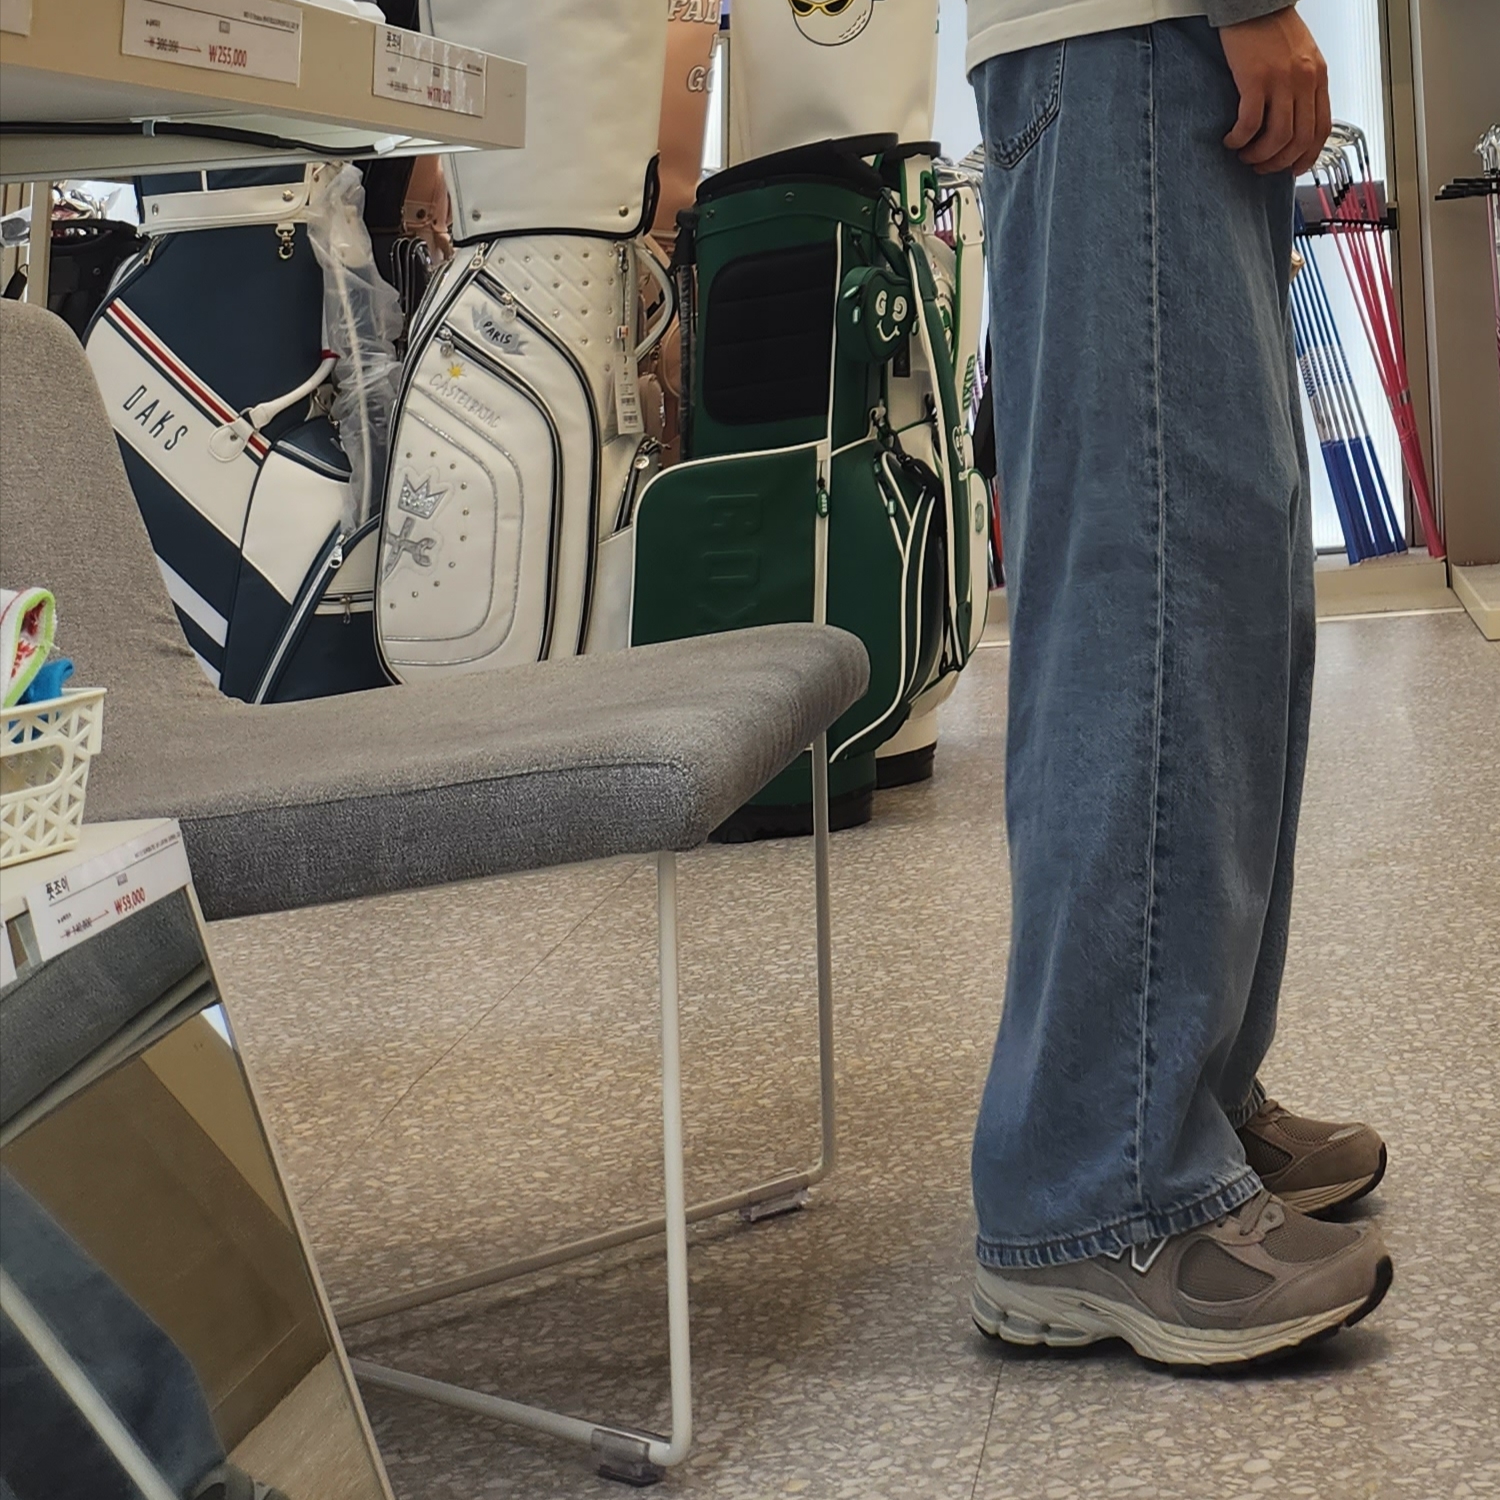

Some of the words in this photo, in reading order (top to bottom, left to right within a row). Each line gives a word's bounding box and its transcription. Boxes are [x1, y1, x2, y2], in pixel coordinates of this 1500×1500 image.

[208, 43, 248, 68] ₩255,000
[483, 321, 513, 344] PARIS
[123, 384, 189, 452] DAKS
[45, 875, 70, 901] 풋조이
[114, 886, 146, 915] ₩59,000
